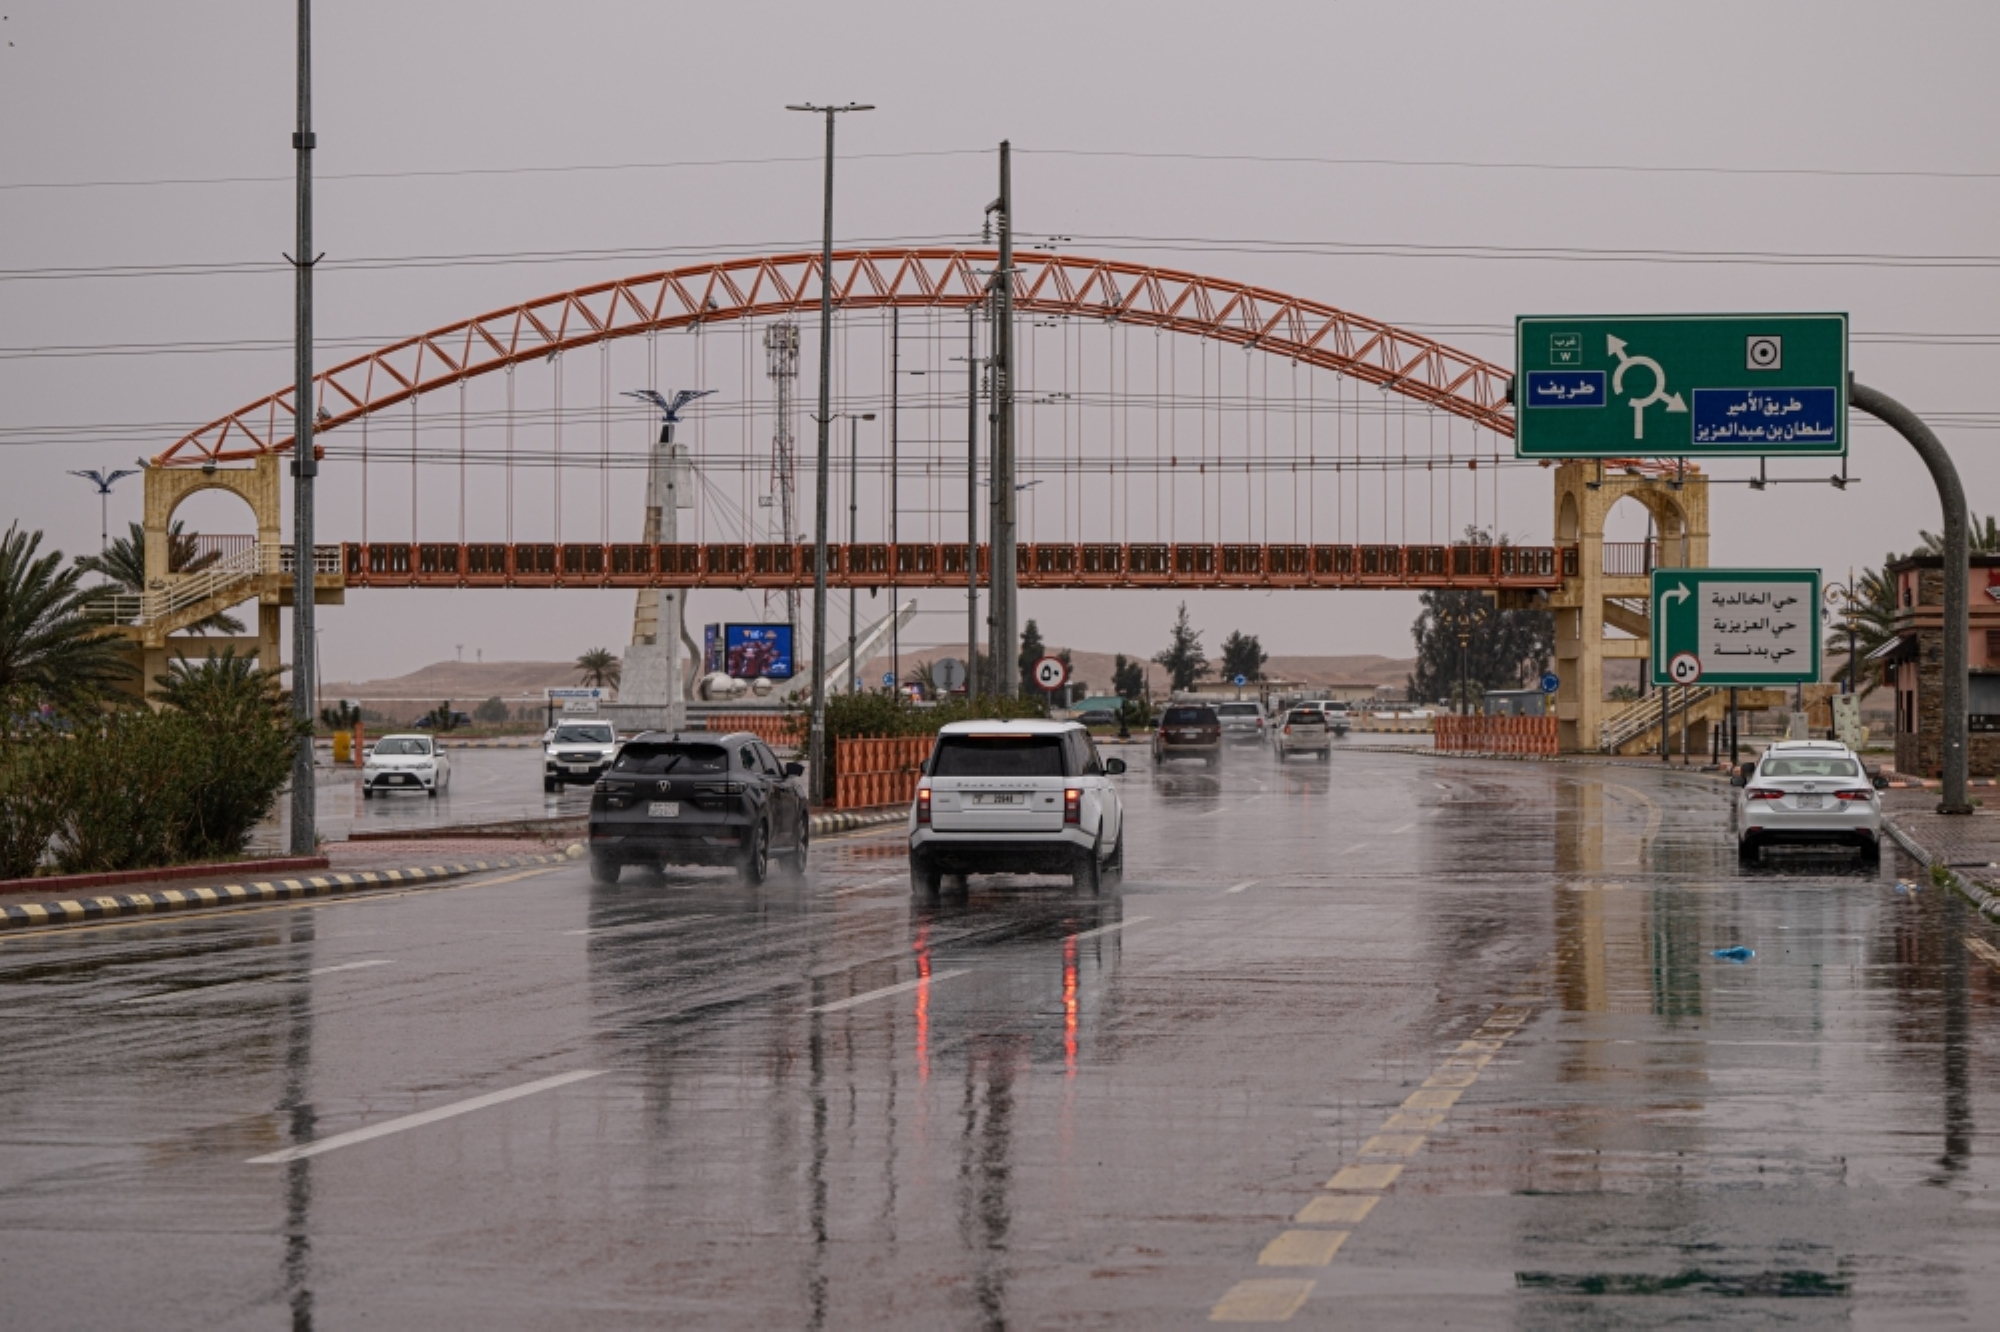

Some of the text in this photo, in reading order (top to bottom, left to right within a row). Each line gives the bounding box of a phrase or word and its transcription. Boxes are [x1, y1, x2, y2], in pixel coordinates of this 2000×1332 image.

[1554, 336, 1576, 347] غرب
[1560, 352, 1571, 361] W
[1537, 380, 1595, 399] طريف
[1726, 391, 1803, 416] طريق الأمير
[1766, 424, 1783, 441] بن
[1784, 420, 1833, 440] سلطان
[1712, 592, 1798, 613] حي الخالدية
[1713, 617, 1797, 638] حي العزيزية
[1771, 647, 1796, 663] حي
[1041, 664, 1059, 681] ٥٠
[1676, 660, 1695, 677] ٥٠
